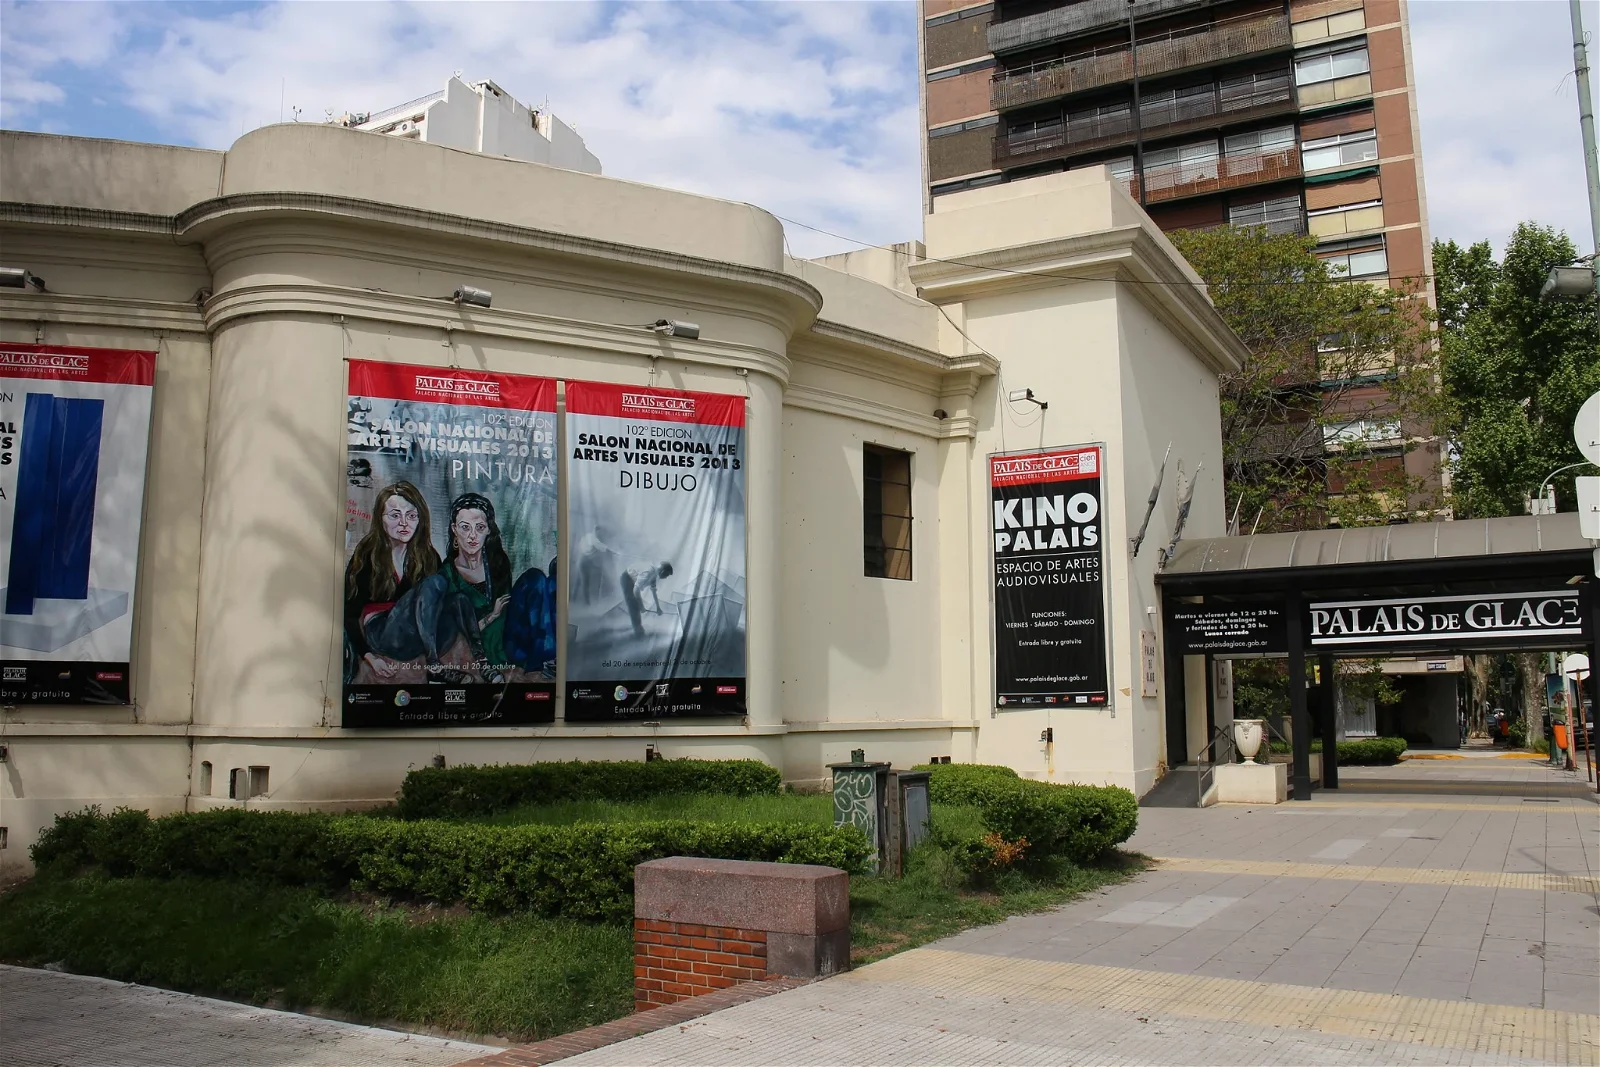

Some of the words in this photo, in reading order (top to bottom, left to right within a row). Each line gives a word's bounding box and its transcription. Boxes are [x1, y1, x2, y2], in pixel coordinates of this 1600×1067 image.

[50, 356, 89, 367] GLACE
[415, 378, 454, 390] PALAIS
[465, 382, 500, 394] GLACE
[621, 395, 655, 407] PALAIS
[665, 399, 696, 410] GLACE
[508, 416, 554, 429] EDICION
[371, 417, 432, 435] SALON
[439, 423, 528, 443] NACIONAL
[533, 431, 553, 445] DE
[651, 427, 692, 439] EDICION
[352, 433, 412, 448] ARTES
[418, 437, 501, 455] VISUALES
[506, 443, 553, 459] 2013
[578, 433, 629, 449] SALON
[635, 438, 713, 455] NACIONAL
[718, 443, 736, 456] DE
[573, 447, 619, 463] ARTES
[624, 452, 695, 468] VISUALES
[700, 457, 741, 470] 2013
[993, 461, 1031, 474] PALAIS
[1043, 456, 1079, 469] GLACE
[452, 459, 554, 485] PINTURA
[620, 470, 697, 492] DIBUJO
[994, 492, 1098, 529] KINO
[995, 525, 1098, 552] PALAIS
[996, 561, 1043, 574] ESPACIO
[1047, 560, 1061, 570] DE
[1065, 557, 1099, 569] ARTES
[996, 571, 1099, 587] AUDIOVISUALES
[1064, 618, 1095, 626] DOMINGO
[1310, 604, 1425, 636] PALAIS
[1430, 613, 1461, 631] DE
[1464, 598, 1582, 629] GLACE
[1060, 638, 1082, 647] gratuita
[412, 661, 422, 669] de
[462, 661, 469, 669] al
[471, 661, 480, 669] 20
[602, 660, 612, 668] del
[613, 660, 622, 668] 20
[0, 687, 18, 698] bre
[22, 691, 27, 699] y
[32, 690, 71, 699] gratuita
[399, 711, 434, 720] Entrada
[438, 711, 458, 720] libre
[614, 705, 645, 714] Entrada
[663, 705, 669, 713] y
[671, 703, 701, 713] gratuita
